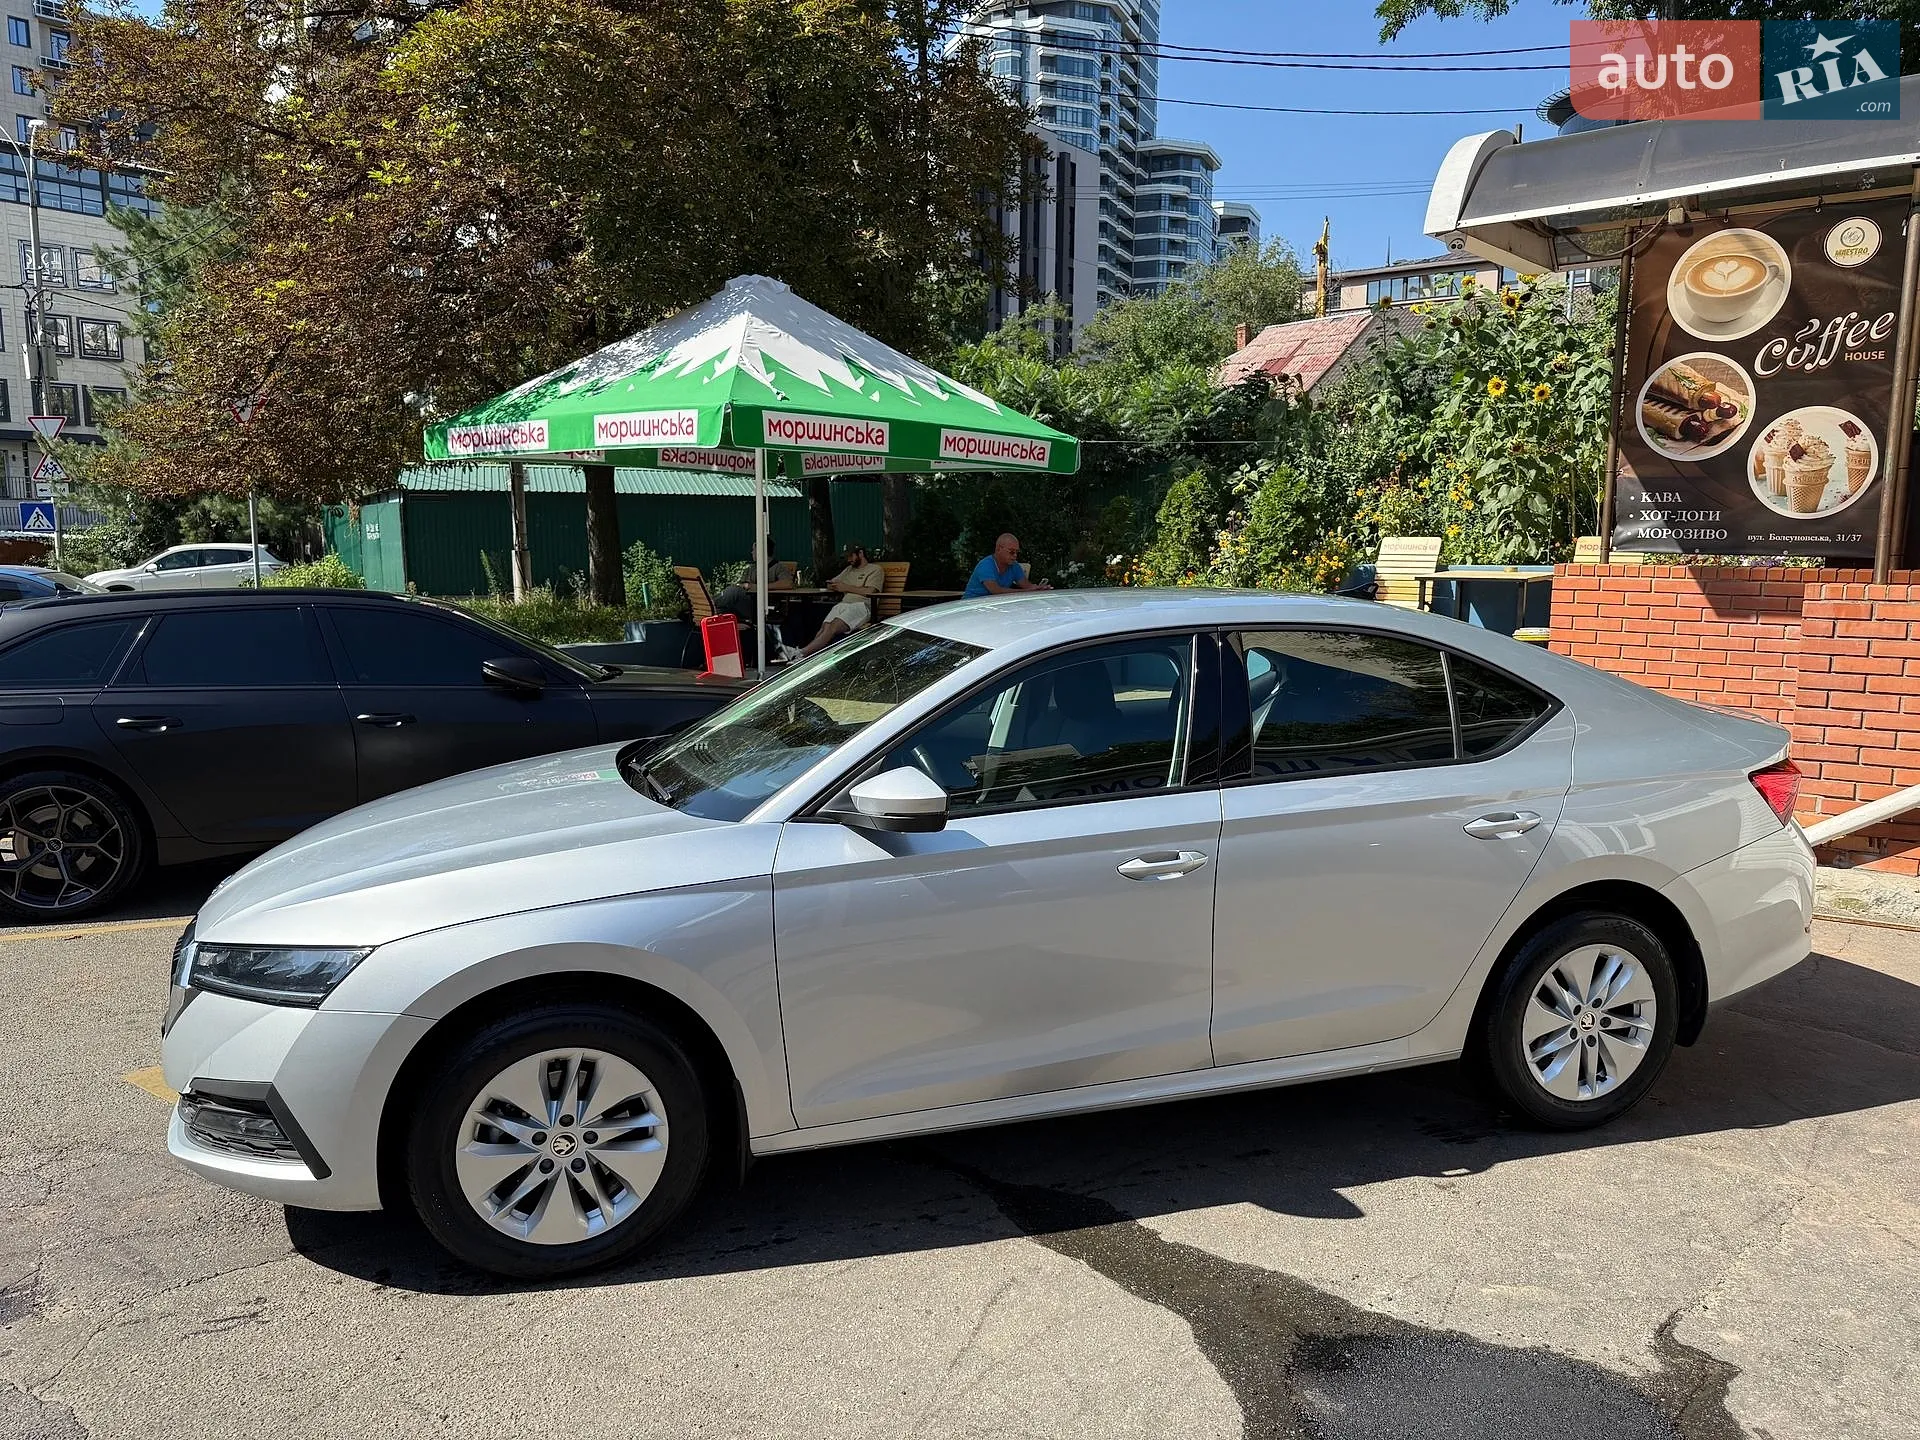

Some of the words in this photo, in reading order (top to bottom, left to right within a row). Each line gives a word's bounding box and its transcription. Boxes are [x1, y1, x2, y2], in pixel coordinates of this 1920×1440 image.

[1753, 310, 1897, 379] Coffee
[1844, 349, 1886, 362] HOUSE
[450, 424, 546, 453] моршинська
[598, 413, 694, 443] моршинська
[767, 418, 886, 446] моршинська
[943, 433, 1047, 462] моршинська
[1640, 491, 1683, 503] КАВА
[1639, 509, 1722, 523] ХОТ-ДОГИ
[1637, 527, 1729, 540] МОРОЗИВО
[1835, 534, 1862, 543] 31/37
